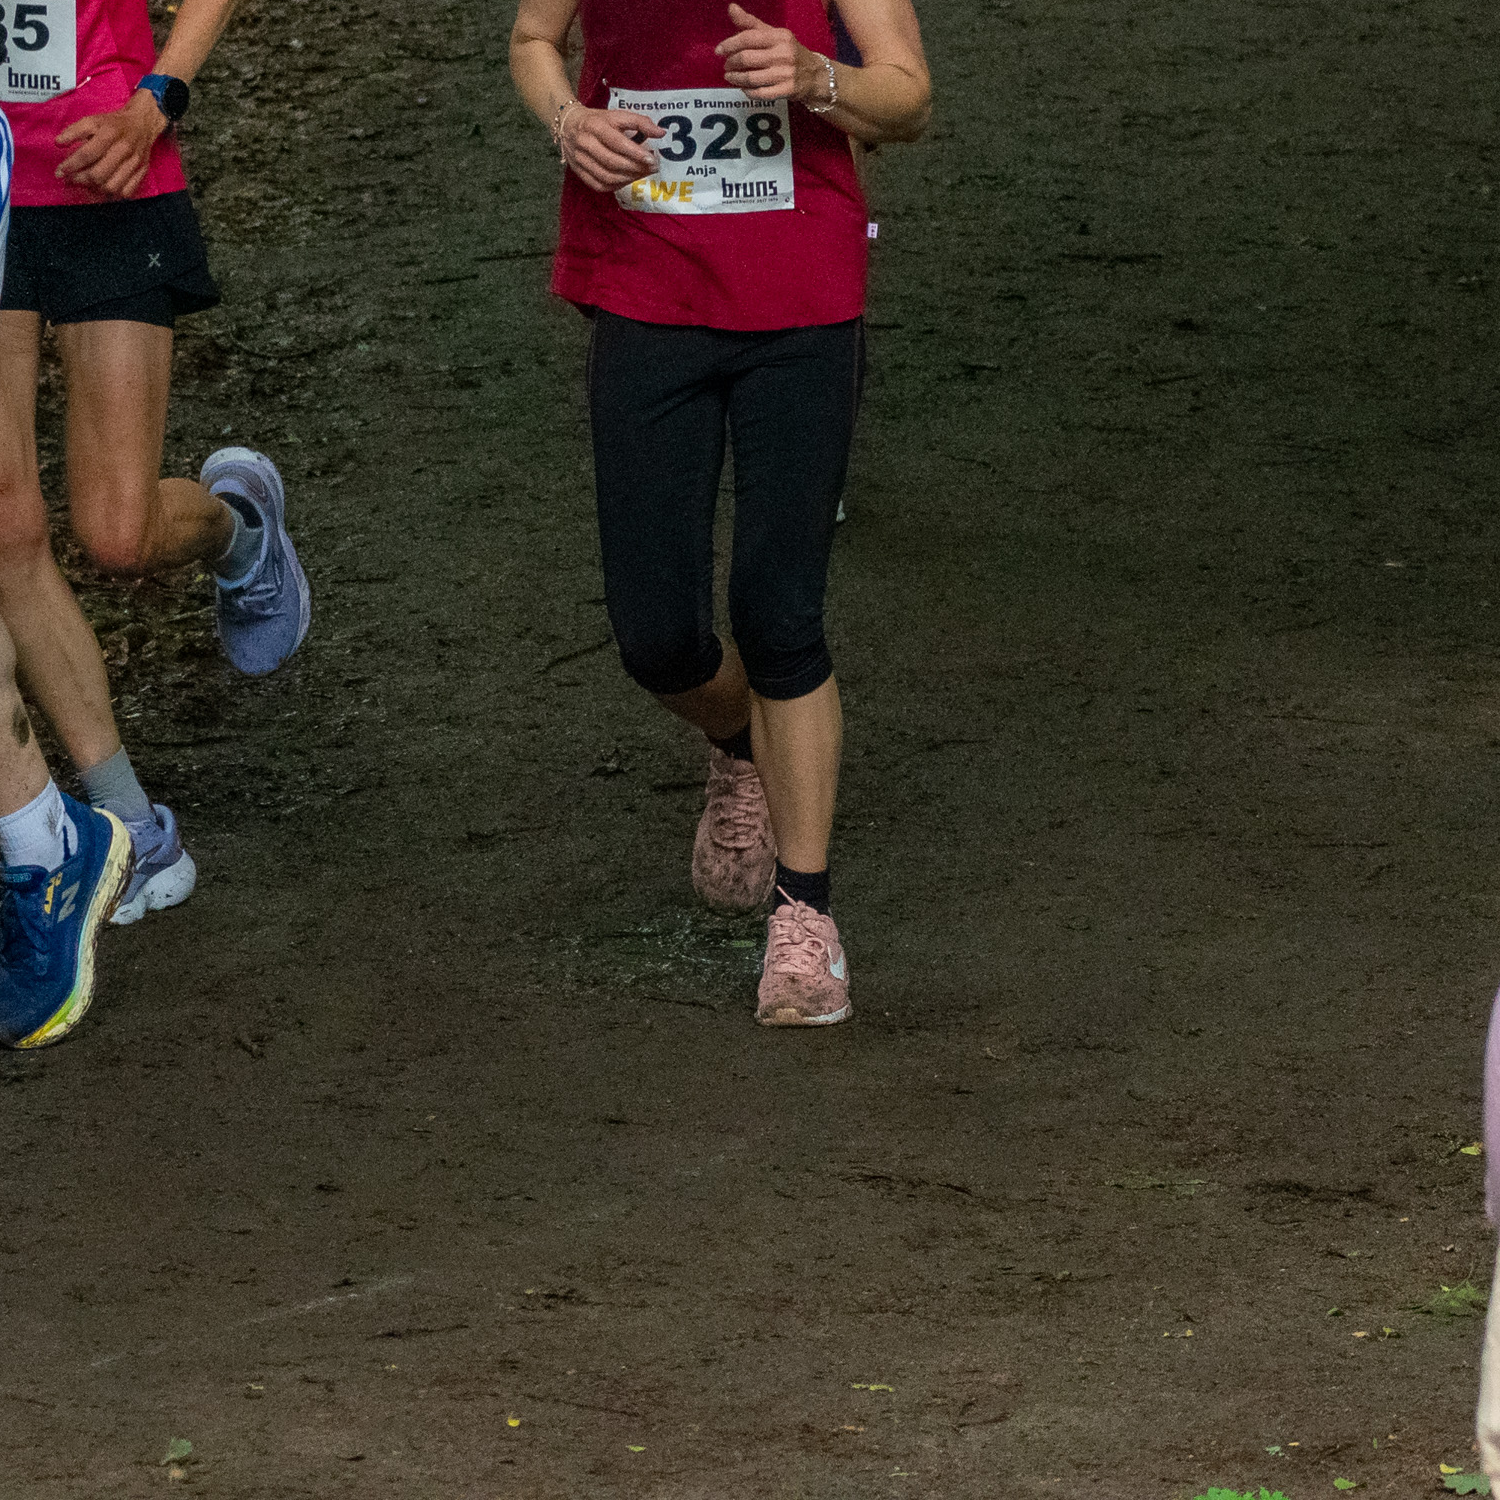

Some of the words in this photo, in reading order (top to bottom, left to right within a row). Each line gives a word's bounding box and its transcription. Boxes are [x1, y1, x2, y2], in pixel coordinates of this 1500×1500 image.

[8, 66, 61, 91] bruns
[618, 99, 690, 111] Everstener
[631, 112, 786, 162] 328
[685, 165, 717, 178] Anja
[630, 179, 695, 204] EWE
[721, 177, 778, 199] bruns
